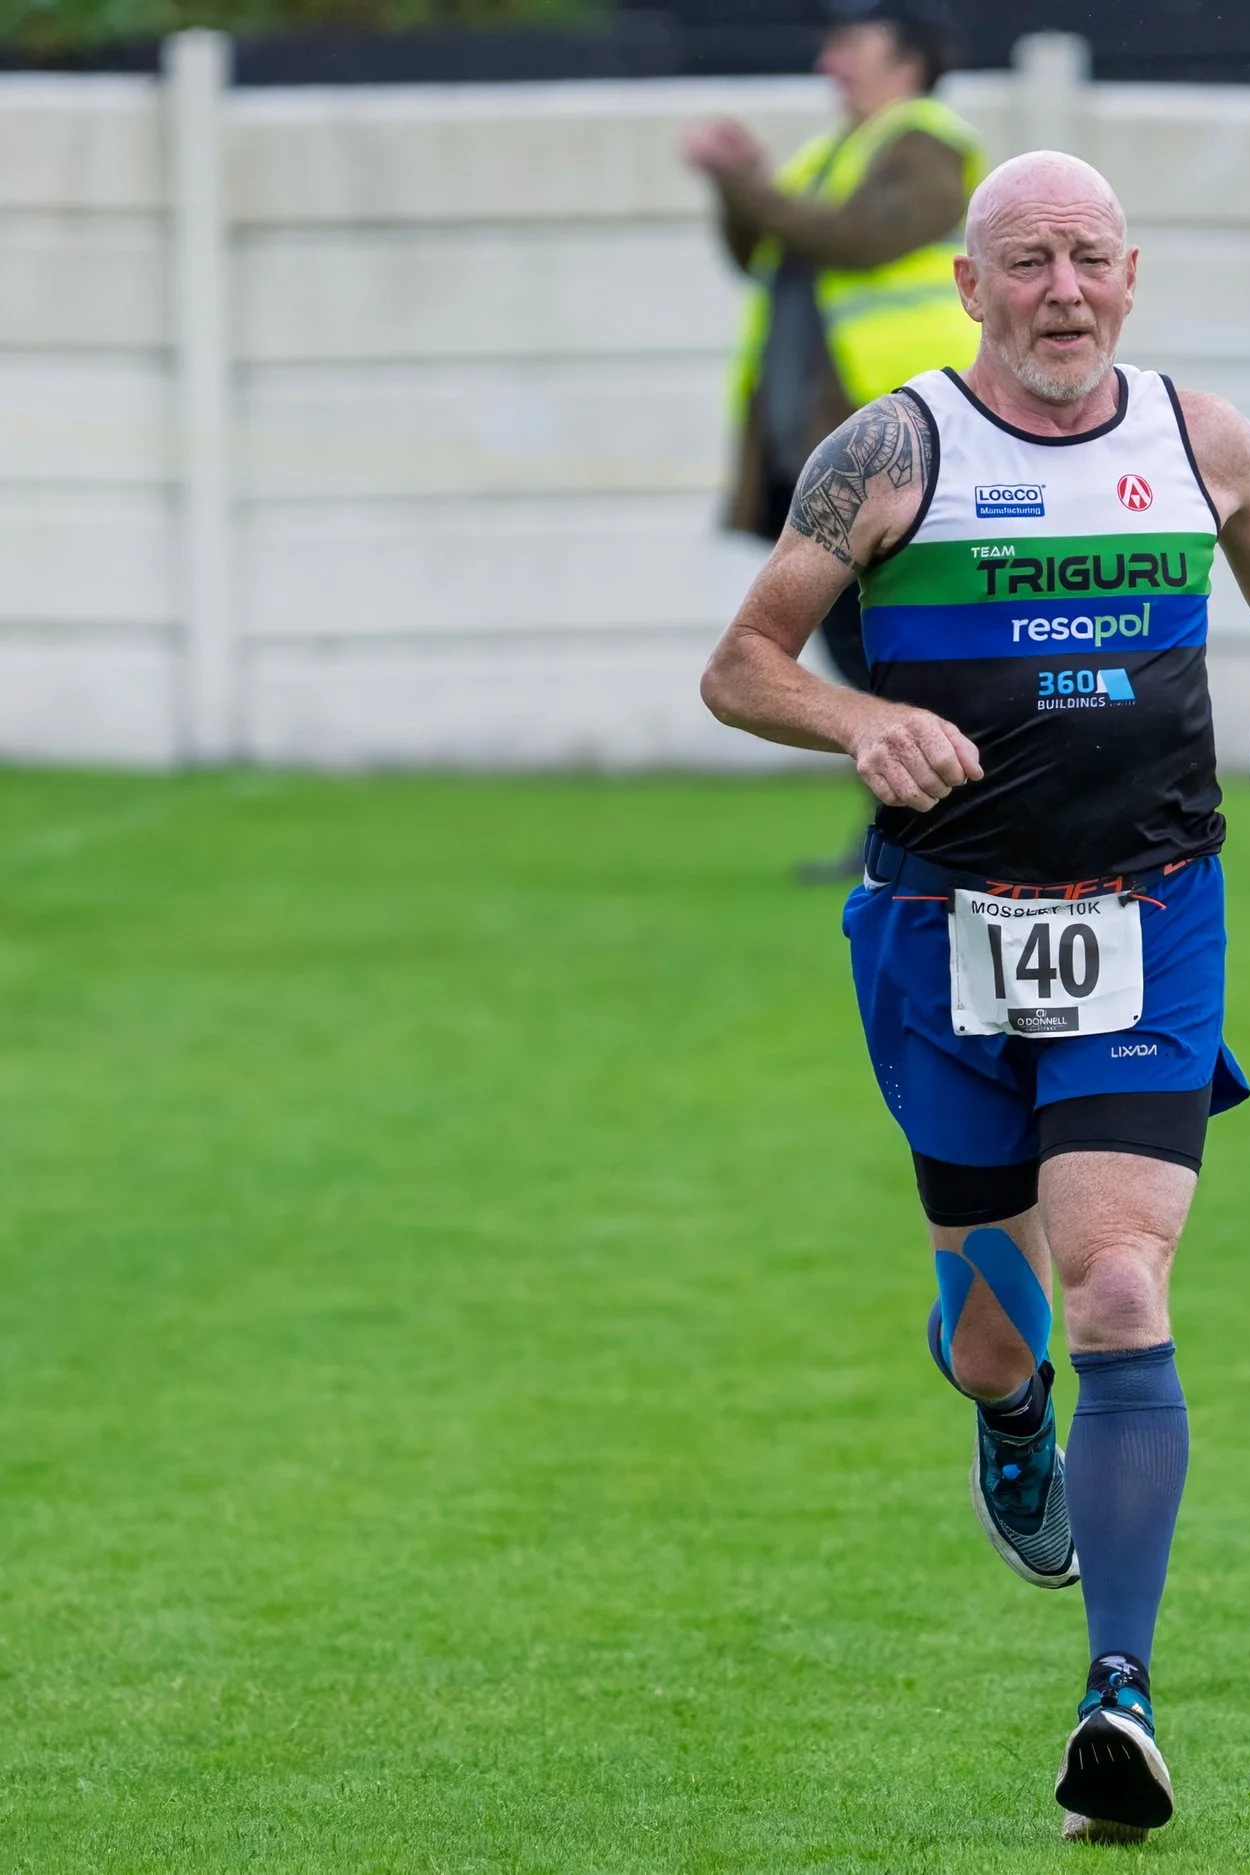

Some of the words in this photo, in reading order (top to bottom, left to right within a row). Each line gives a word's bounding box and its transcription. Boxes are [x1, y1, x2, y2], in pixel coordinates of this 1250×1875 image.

[979, 489, 1038, 501] LOGCO
[971, 545, 1015, 558] TEAM
[976, 552, 1187, 596] TRIGURU
[1012, 603, 1150, 647] resapol
[1038, 670, 1094, 696] 360
[1037, 697, 1106, 710] BUILDINGS
[1067, 901, 1101, 916] 10K
[987, 922, 1100, 1000] 140
[1111, 1044, 1157, 1058] LIXADA
